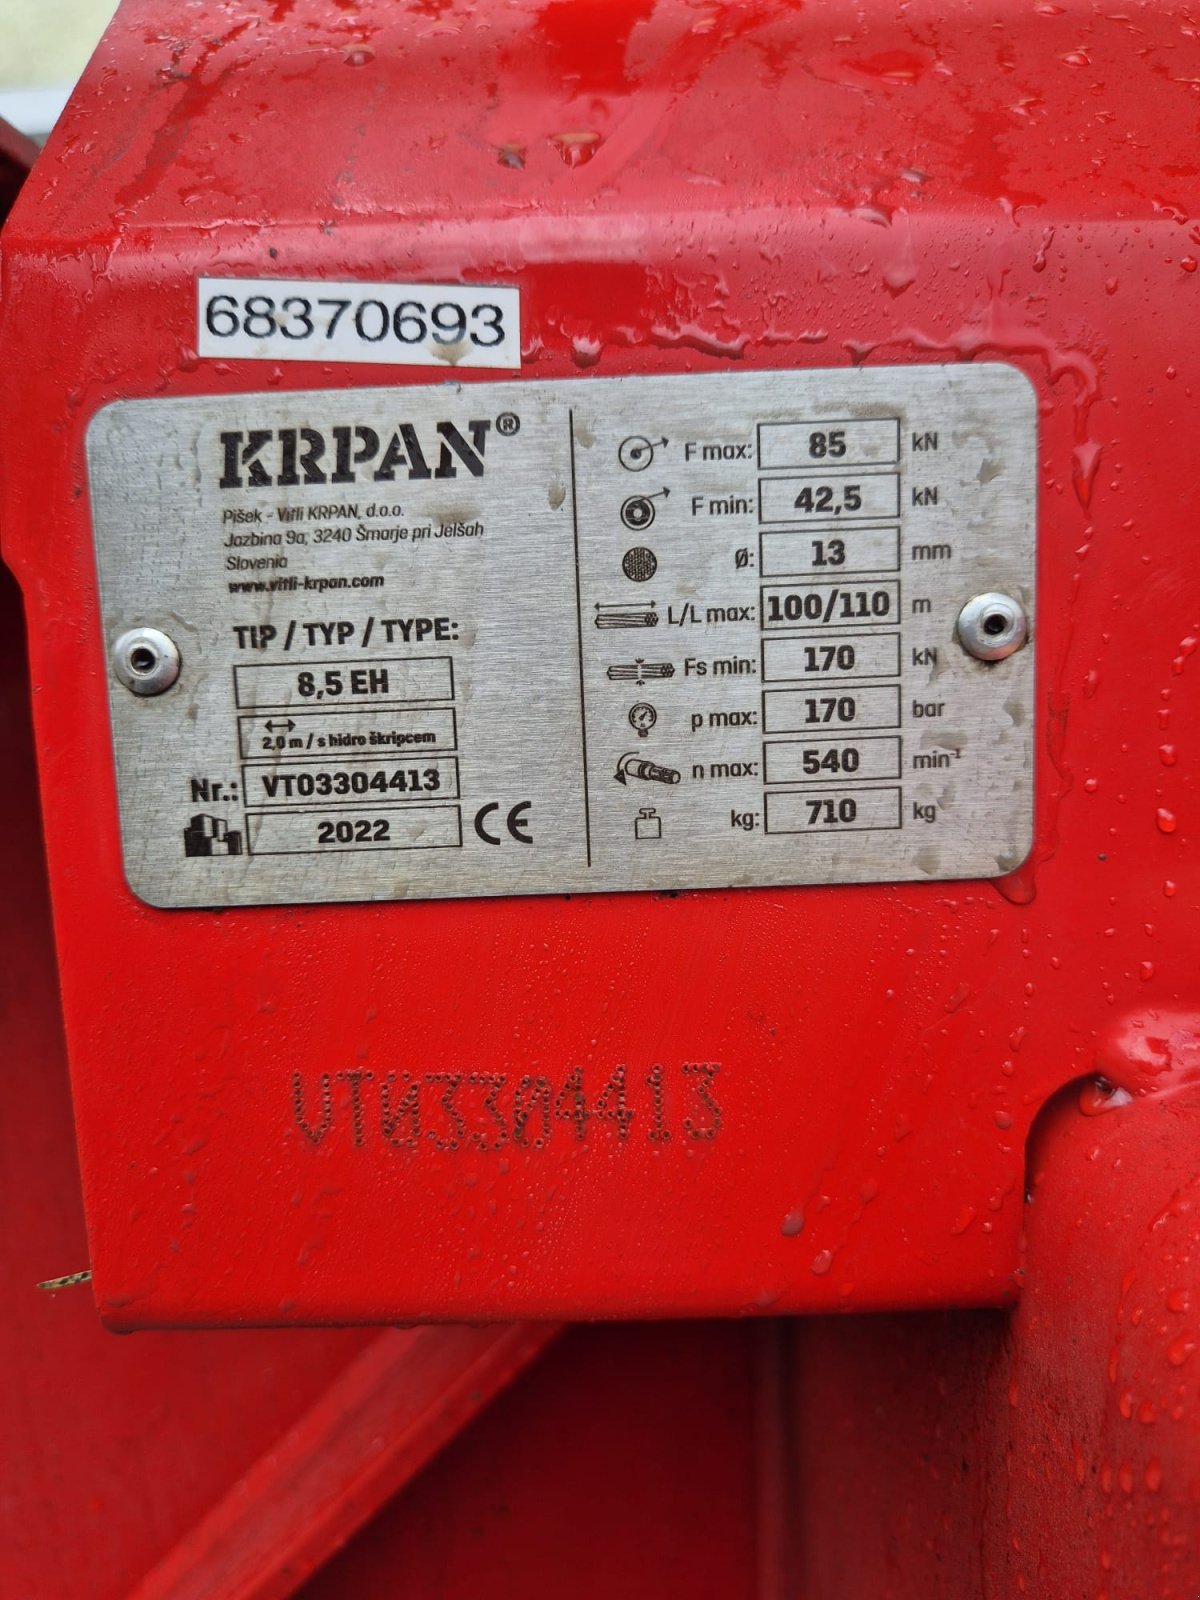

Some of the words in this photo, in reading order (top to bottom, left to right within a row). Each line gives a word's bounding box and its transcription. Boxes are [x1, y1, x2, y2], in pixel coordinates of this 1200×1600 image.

[206, 295, 505, 347] 68370693
[685, 443, 697, 461] F
[702, 443, 752, 460] max:
[808, 431, 847, 459] 85
[911, 432, 938, 451] kN
[222, 507, 262, 524] Pišek
[277, 506, 304, 522] Vitli
[307, 505, 361, 521] KRPAN,
[366, 503, 405, 518] d.o.o.
[692, 497, 703, 516] F
[709, 495, 753, 514] min:
[794, 485, 862, 515] 42,5
[911, 486, 938, 506] kN
[224, 531, 282, 548] Jazbina
[313, 528, 352, 543] 3240
[356, 524, 408, 543] Šmarje
[412, 527, 431, 542] pri
[434, 522, 484, 539] Jelšah
[226, 555, 288, 571] Slovenia
[811, 540, 846, 567] 13
[911, 543, 952, 560] mm
[228, 574, 385, 593] www.vitli-krpan.com
[667, 603, 703, 626] L/L
[706, 606, 755, 623] max:
[767, 589, 890, 623] 100/110
[912, 598, 931, 613] m
[233, 624, 277, 649] TIP
[284, 620, 297, 650] /
[303, 621, 354, 646] TYP
[361, 617, 375, 647] /
[381, 617, 459, 643] TYPE:
[685, 658, 707, 676] Fs
[712, 656, 756, 674] min:
[804, 645, 855, 672] 170
[912, 648, 937, 666] kN
[297, 671, 343, 700] 8,5
[350, 669, 389, 695] EH
[691, 713, 703, 732] p
[709, 709, 757, 727] max:
[804, 697, 856, 723] 170
[913, 700, 945, 717] bar
[262, 735, 286, 750] 2,0
[289, 735, 303, 748] m
[329, 732, 366, 748] hidro
[369, 730, 436, 747] škripcem
[693, 764, 704, 778] n
[710, 761, 759, 778] max:
[803, 748, 859, 775] 540
[190, 778, 238, 802] Nr.:
[262, 768, 441, 797] VT03304413
[731, 809, 760, 830] kg:
[805, 798, 857, 824] 710
[914, 801, 936, 821] kg
[318, 819, 390, 843] 2022
